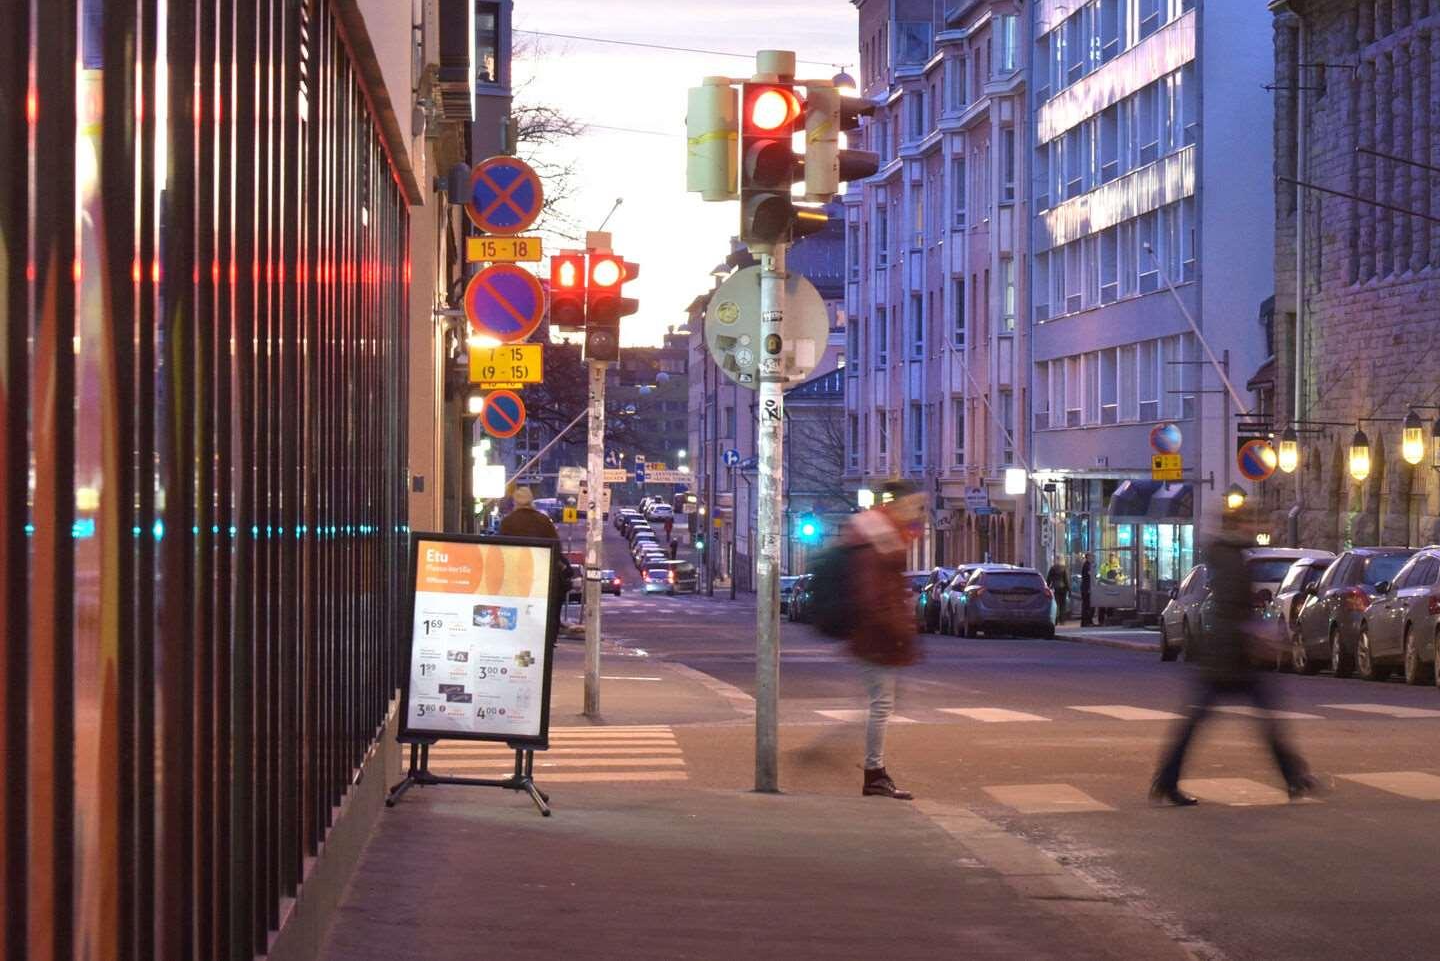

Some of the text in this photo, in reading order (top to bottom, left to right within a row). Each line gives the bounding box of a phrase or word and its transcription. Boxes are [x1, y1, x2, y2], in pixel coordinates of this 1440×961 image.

[481, 241, 497, 257] 15
[512, 241, 528, 258] 18
[488, 348, 496, 362] 7
[511, 348, 523, 362] 15
[482, 366, 496, 380] (9
[511, 366, 529, 380] 15)
[426, 548, 449, 563] Etu
